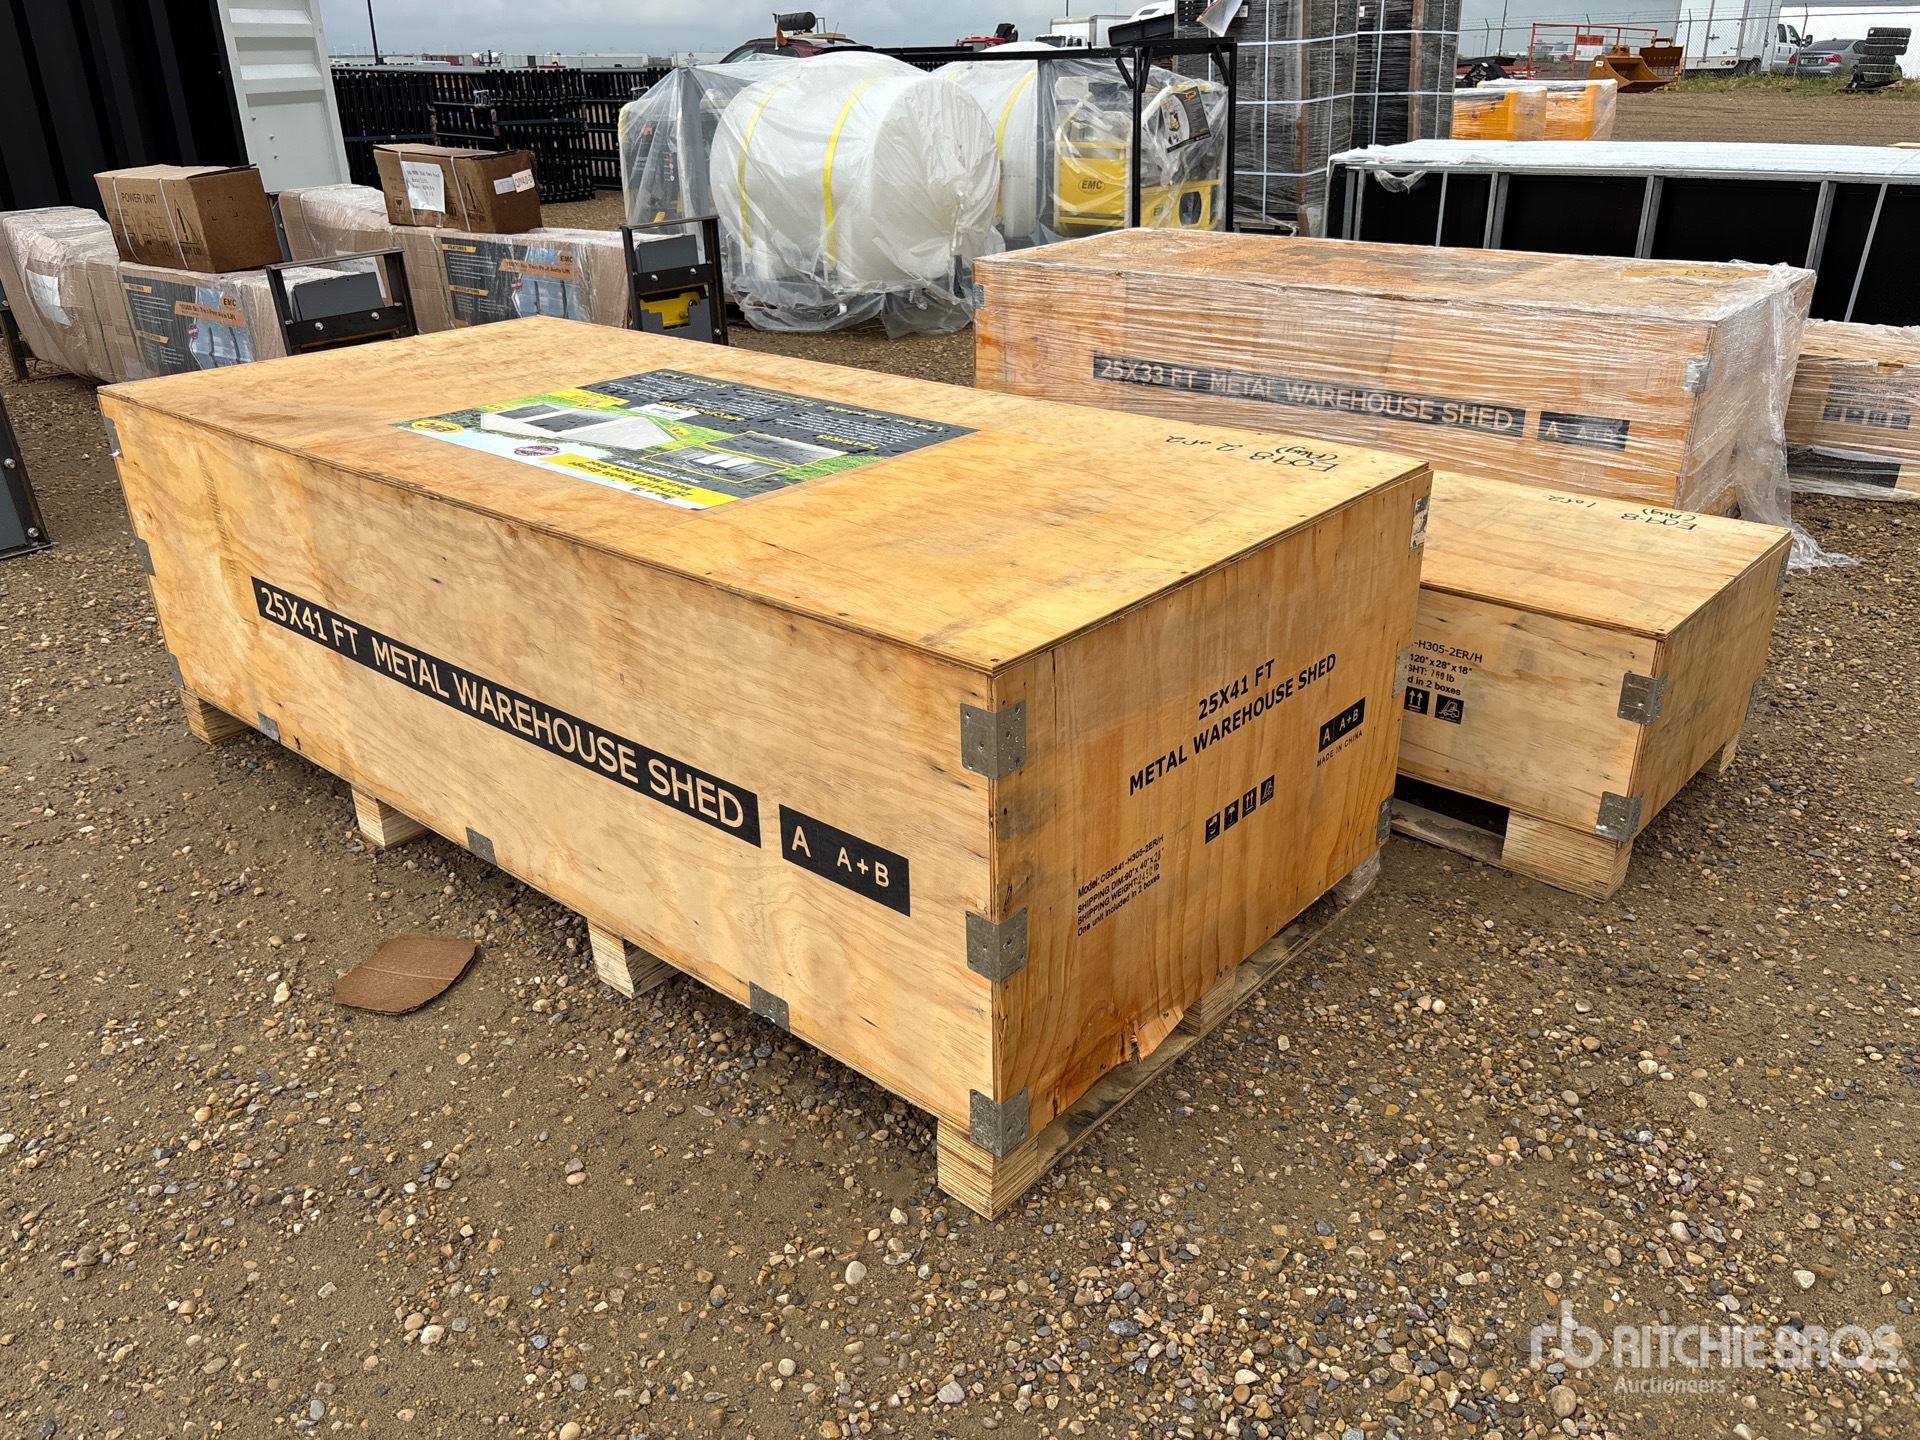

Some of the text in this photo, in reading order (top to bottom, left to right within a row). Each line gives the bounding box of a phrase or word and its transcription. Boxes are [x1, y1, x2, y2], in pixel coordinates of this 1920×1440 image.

[1081, 181, 1103, 190] EMC
[121, 193, 157, 205] POWER UNIT
[560, 255, 574, 263] EMC
[223, 298, 237, 307] EMC
[1101, 358, 1513, 431] 25X33 FT METAL WAREHOUSE SHED
[1166, 435, 1185, 443] 2
[1545, 421, 1559, 438] A
[1216, 442, 1243, 452] 2
[1275, 446, 1338, 462] (Aug)
[1642, 508, 1696, 522] (Aug)
[1415, 677, 1424, 687] in
[1426, 680, 1433, 689] 2
[1434, 682, 1461, 696] boxes
[1446, 673, 1455, 683] lb
[1198, 658, 1275, 720] 25X41 FT
[260, 586, 744, 829] 25X41 FT METAL WAREHOUSE SHED
[1129, 653, 1337, 796] METAL WAREHOUSE SHED
[1322, 708, 1359, 745] A A+B
[1317, 730, 1363, 768] MADE IN CHINA
[791, 825, 890, 888] A A+B
[1078, 876, 1100, 899] Model:
[1078, 885, 1110, 914] SHIPPING
[1078, 873, 1160, 937] One unit included in 2 boxes
[1078, 896, 1110, 926] SHIPPING
